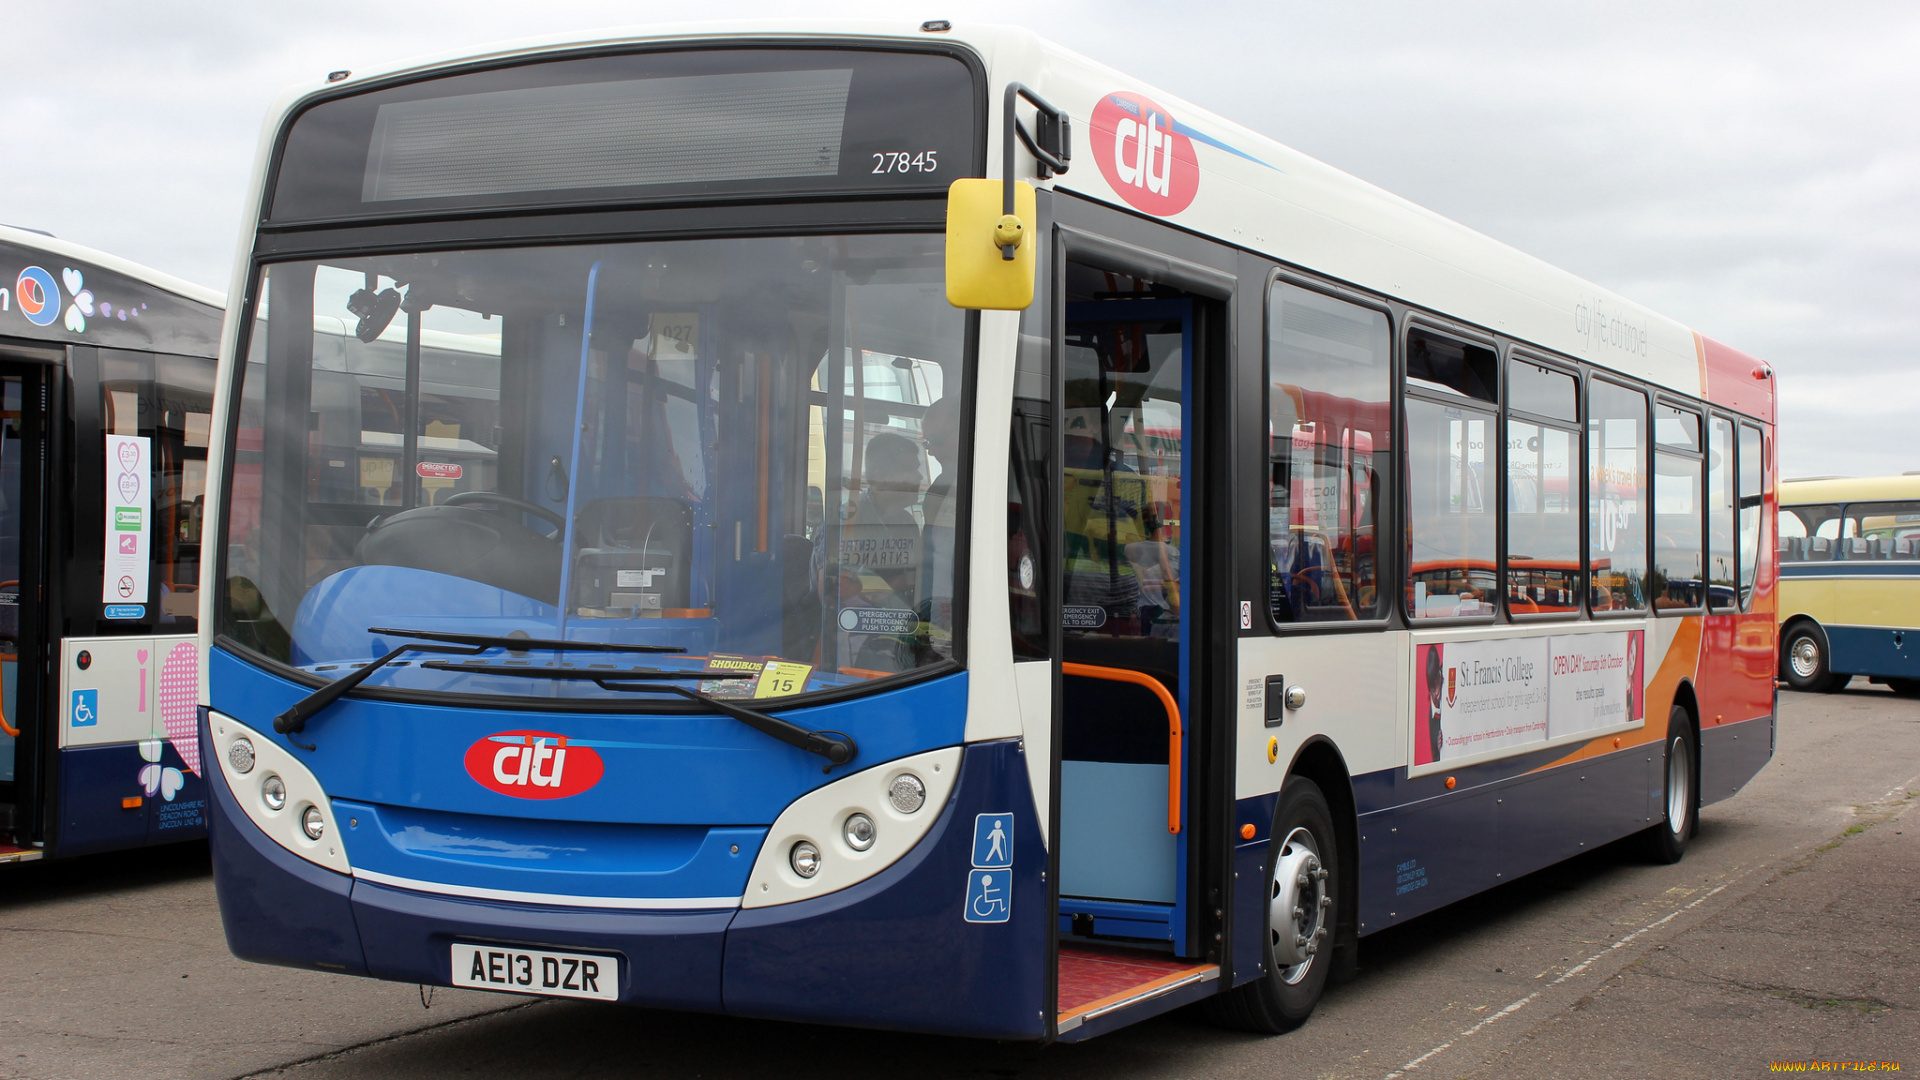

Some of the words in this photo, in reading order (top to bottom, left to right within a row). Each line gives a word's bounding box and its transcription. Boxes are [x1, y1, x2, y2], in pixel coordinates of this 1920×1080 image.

[1115, 104, 1172, 197] citi
[872, 150, 937, 174] 27845
[1575, 296, 1592, 350] city
[1625, 319, 1648, 357] travel
[859, 611, 897, 619] EMERGENCY
[709, 659, 763, 671] SHOWBUS
[1461, 661, 1471, 687] St.
[1505, 656, 1533, 686] College
[1553, 656, 1569, 675] OPEN
[1570, 654, 1582, 673] DAY
[1582, 656, 1599, 675] Saturday
[1607, 653, 1623, 669] October
[772, 679, 793, 692] 15
[493, 735, 567, 787] citi
[160, 801, 197, 812] LINCOLNSHIRE
[160, 811, 182, 820] DEACON
[184, 809, 199, 817] ROAD
[159, 820, 183, 829] LINCOLN
[471, 951, 532, 986] AE13
[542, 957, 599, 993] DZR
